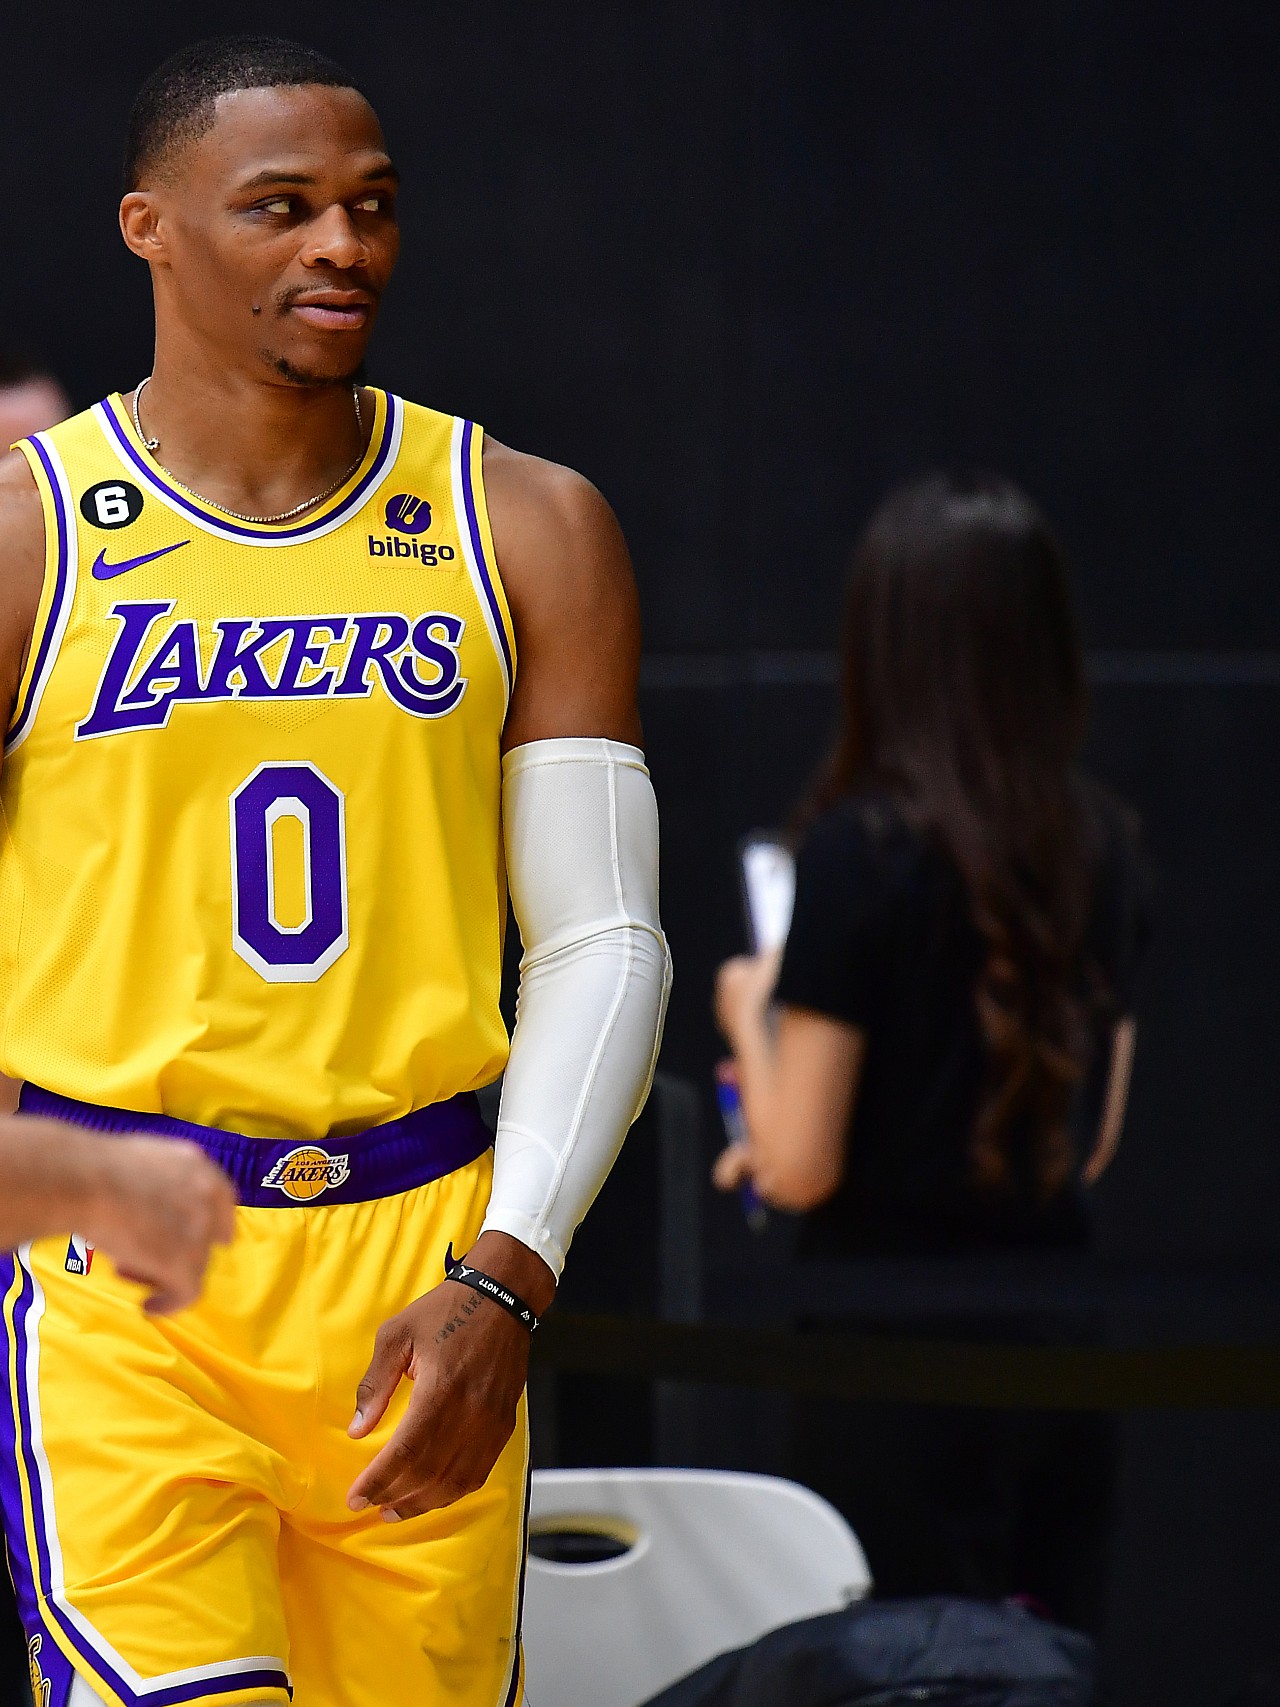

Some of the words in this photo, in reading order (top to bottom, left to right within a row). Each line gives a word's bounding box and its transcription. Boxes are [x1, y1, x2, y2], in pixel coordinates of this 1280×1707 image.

[94, 486, 128, 525] 6
[368, 535, 455, 567] bibigo
[74, 598, 468, 742] LAKERS
[228, 760, 350, 984] 0
[266, 1160, 349, 1186] LAKERS
[66, 1258, 82, 1273] NBA
[478, 1278, 500, 1295] NOT?
[497, 1292, 515, 1307] WHY
